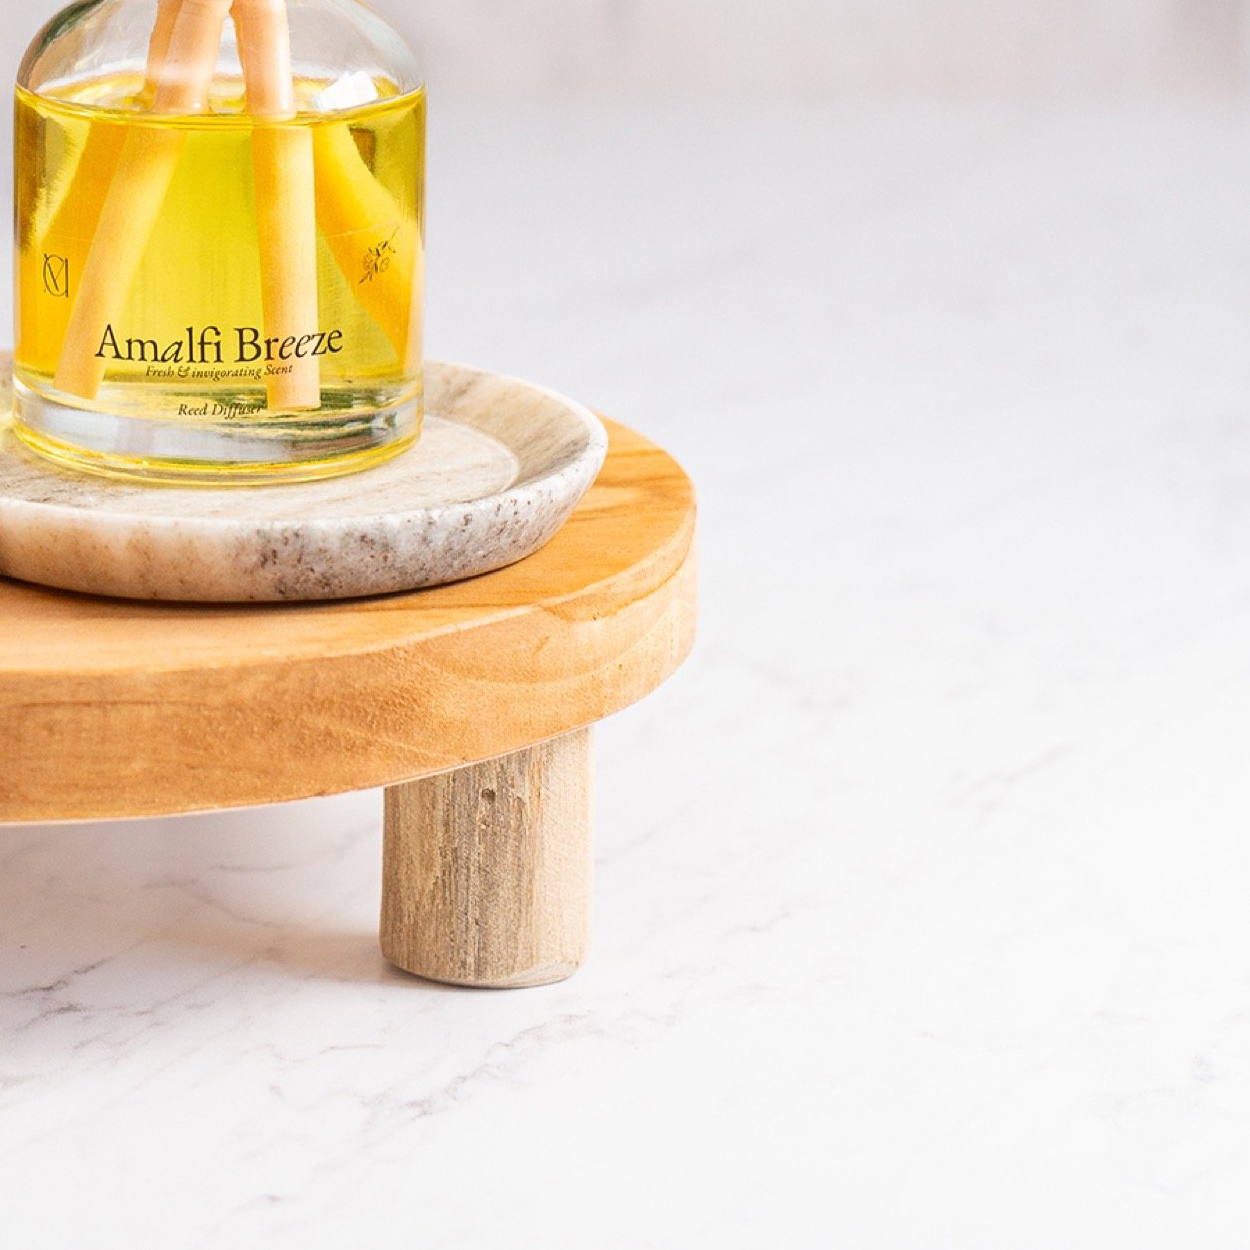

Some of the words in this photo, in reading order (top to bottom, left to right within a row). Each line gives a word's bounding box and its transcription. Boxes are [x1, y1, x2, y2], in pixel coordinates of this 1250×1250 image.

[94, 324, 224, 364] Amalfi
[234, 326, 344, 364] Breeze
[146, 365, 175, 378] Fresh
[177, 365, 191, 379] &
[191, 366, 262, 381] invigorating
[264, 363, 294, 377] Scent
[178, 403, 208, 417] Reed
[211, 402, 262, 420] Diffuser
